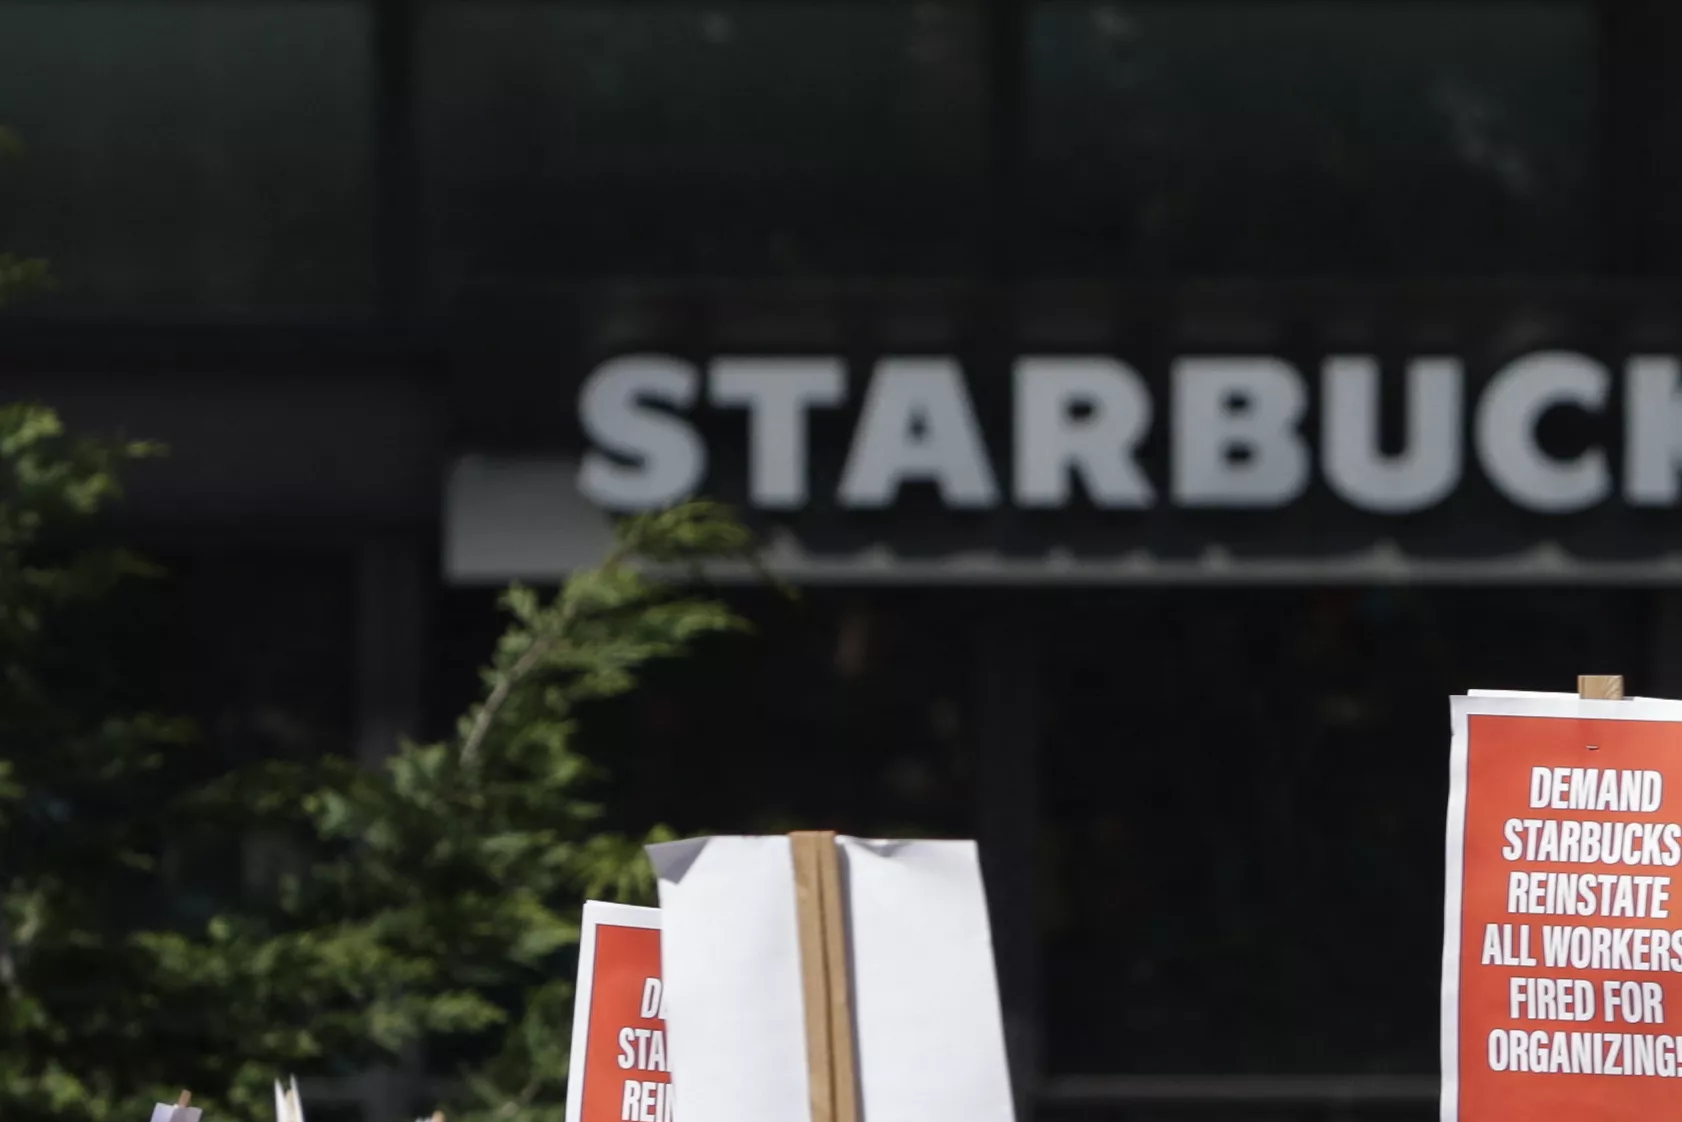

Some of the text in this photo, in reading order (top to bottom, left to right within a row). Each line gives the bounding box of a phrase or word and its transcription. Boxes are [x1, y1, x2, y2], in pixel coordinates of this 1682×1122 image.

[1531, 767, 1661, 812] DEMAND
[1503, 819, 1681, 866] STARBUCKS
[1509, 872, 1670, 918] REINSTATE
[1482, 924, 1536, 966] ALL
[1511, 978, 1663, 1023] FIRED FOR
